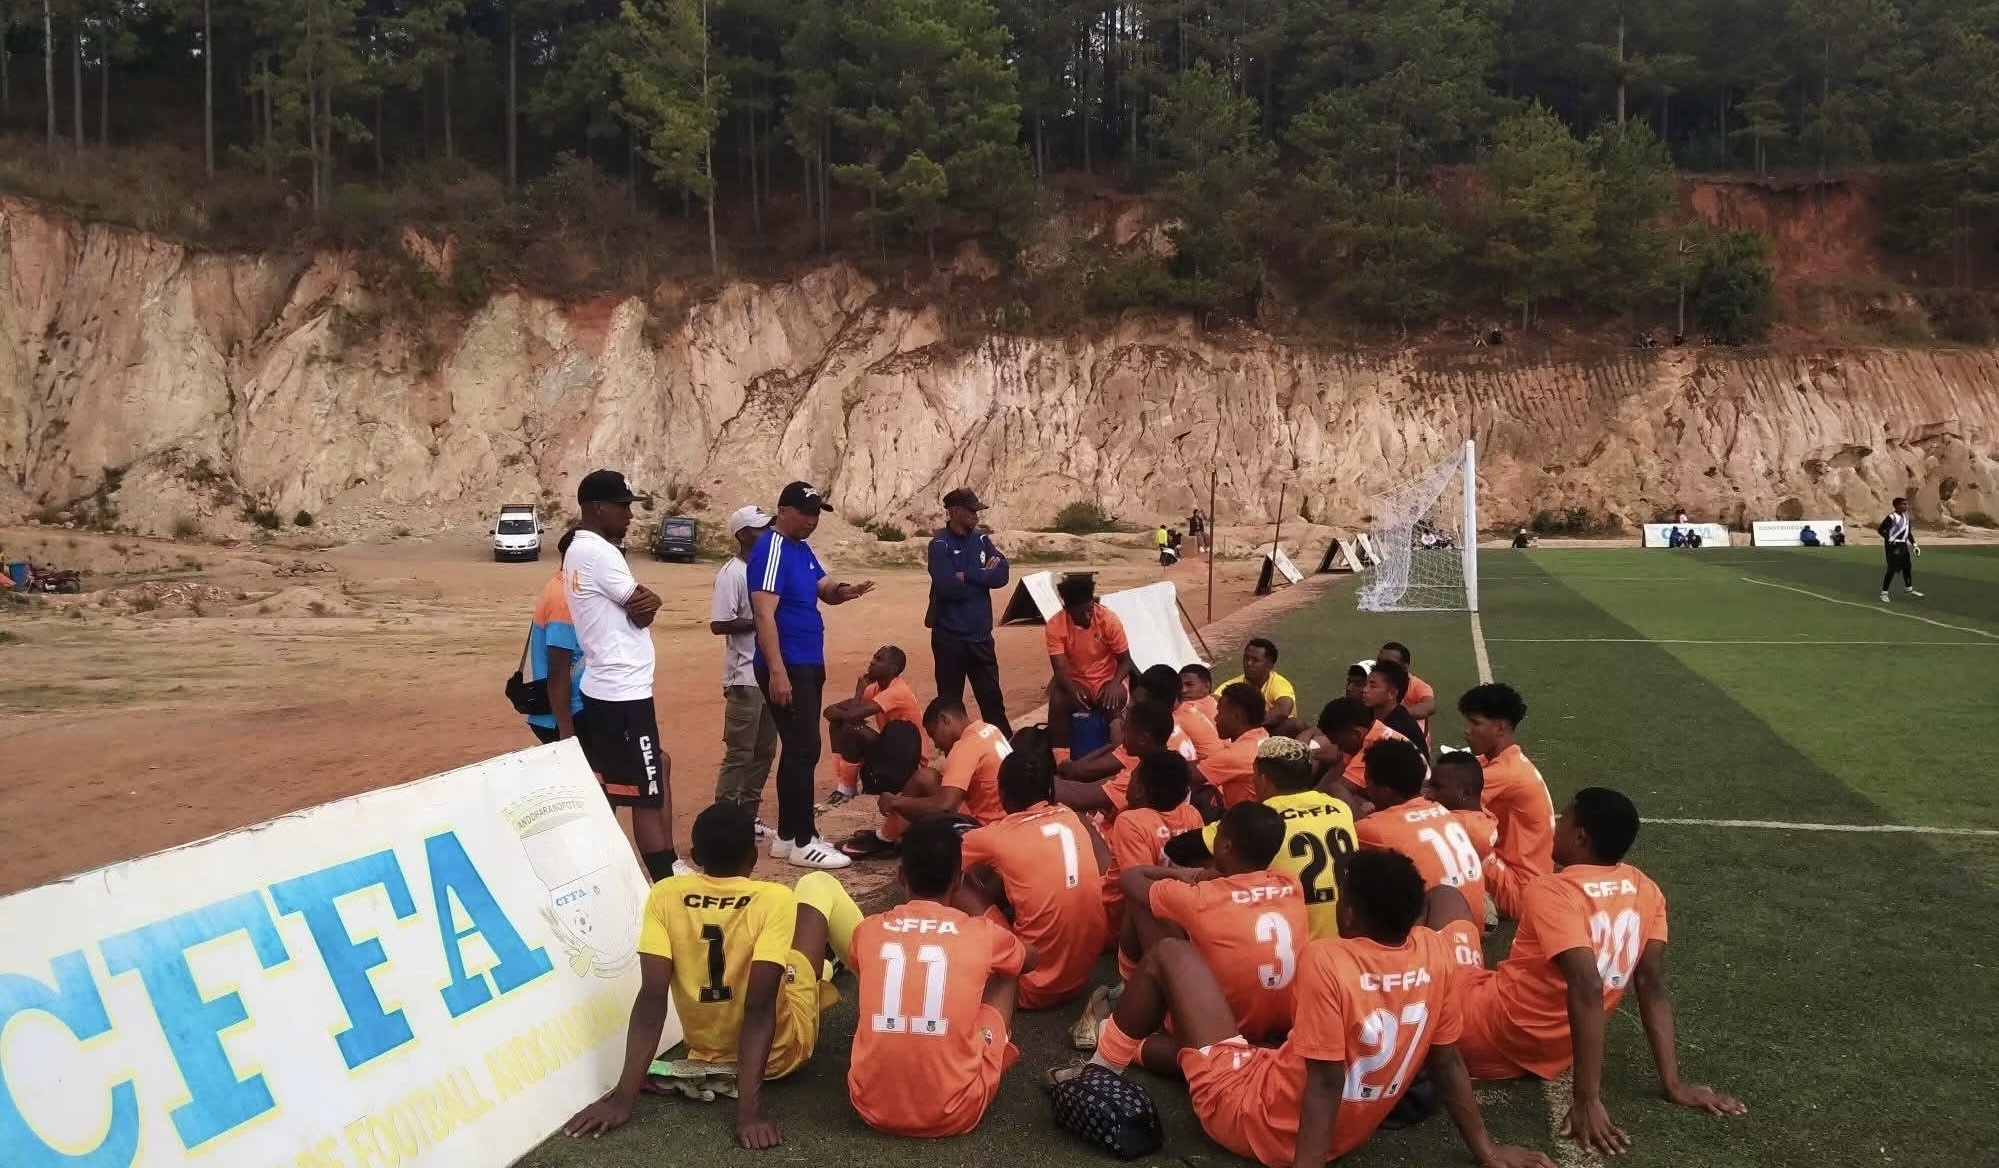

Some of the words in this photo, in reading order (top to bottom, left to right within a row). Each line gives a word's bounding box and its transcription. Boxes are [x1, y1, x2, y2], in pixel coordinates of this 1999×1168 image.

[640, 735, 659, 796] CFFA
[1040, 822, 1079, 889] 7
[1417, 822, 1482, 887] 18
[555, 888, 588, 907] CFFA
[683, 894, 752, 910] CFFA
[882, 918, 960, 935] CFFA
[1231, 885, 1294, 904] CFFA
[699, 923, 733, 1003] 1
[1255, 911, 1296, 990] 3
[1360, 966, 1431, 992] CFFA
[0, 830, 554, 1168] CFFA
[872, 942, 948, 1036] 11
[1341, 1000, 1429, 1102] 27
